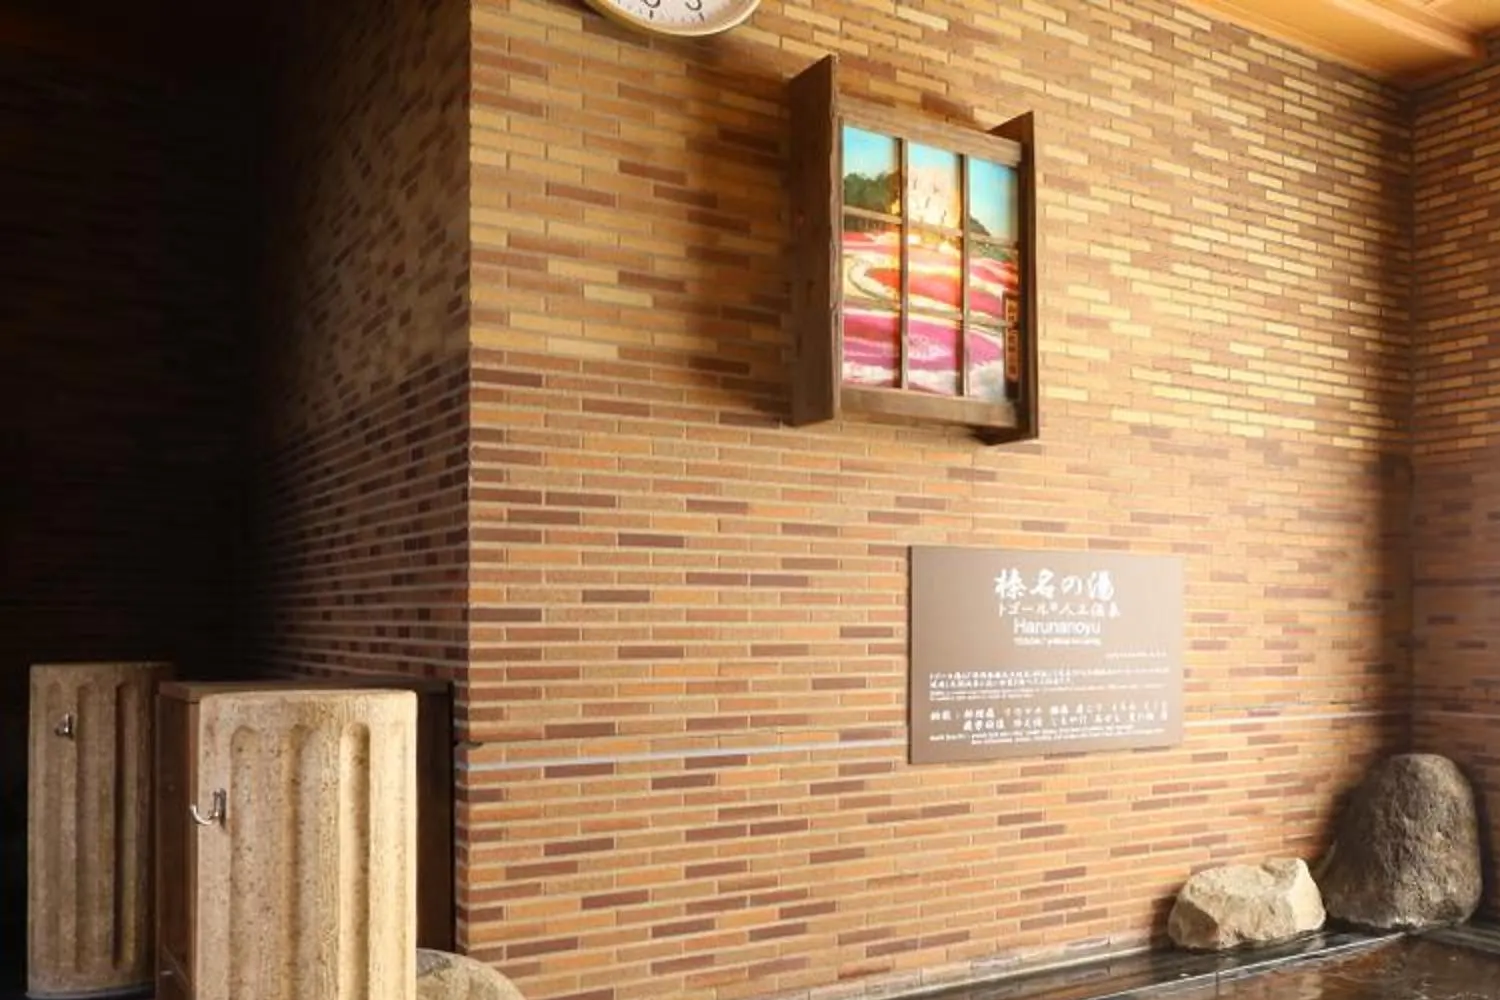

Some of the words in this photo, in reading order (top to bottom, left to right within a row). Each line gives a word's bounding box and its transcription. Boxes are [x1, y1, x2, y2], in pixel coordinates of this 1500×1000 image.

[994, 568, 1114, 601] 榛名の湯
[1013, 617, 1101, 636] Harunanoyu
